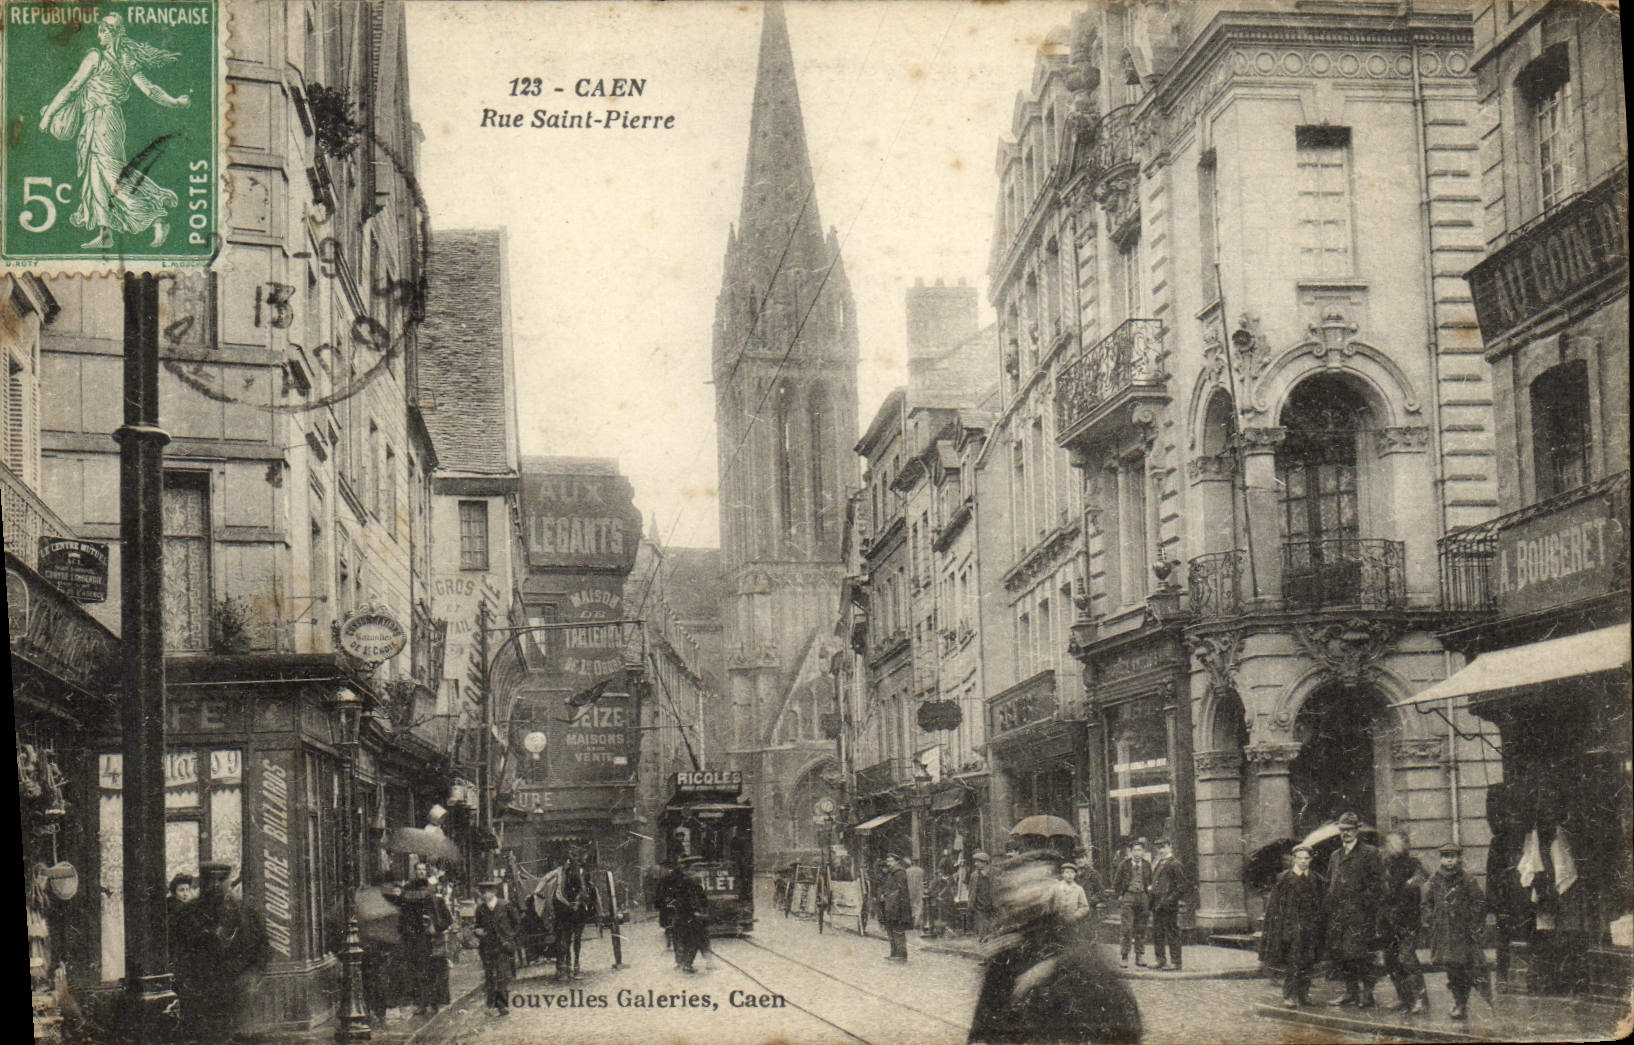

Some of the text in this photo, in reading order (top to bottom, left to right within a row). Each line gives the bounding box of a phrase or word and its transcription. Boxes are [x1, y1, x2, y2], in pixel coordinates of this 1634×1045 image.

[10, 6, 210, 27] REPUBLIQUE FRANÇAISE
[188, 158, 209, 247] POSTES
[538, 480, 606, 504] AUX
[434, 579, 475, 597] GROS
[570, 589, 621, 608] MAISON
[566, 734, 624, 745] MAISONS
[677, 771, 741, 785] RICQLES
[262, 758, 292, 958] AUX QUATRE BILLARDS
